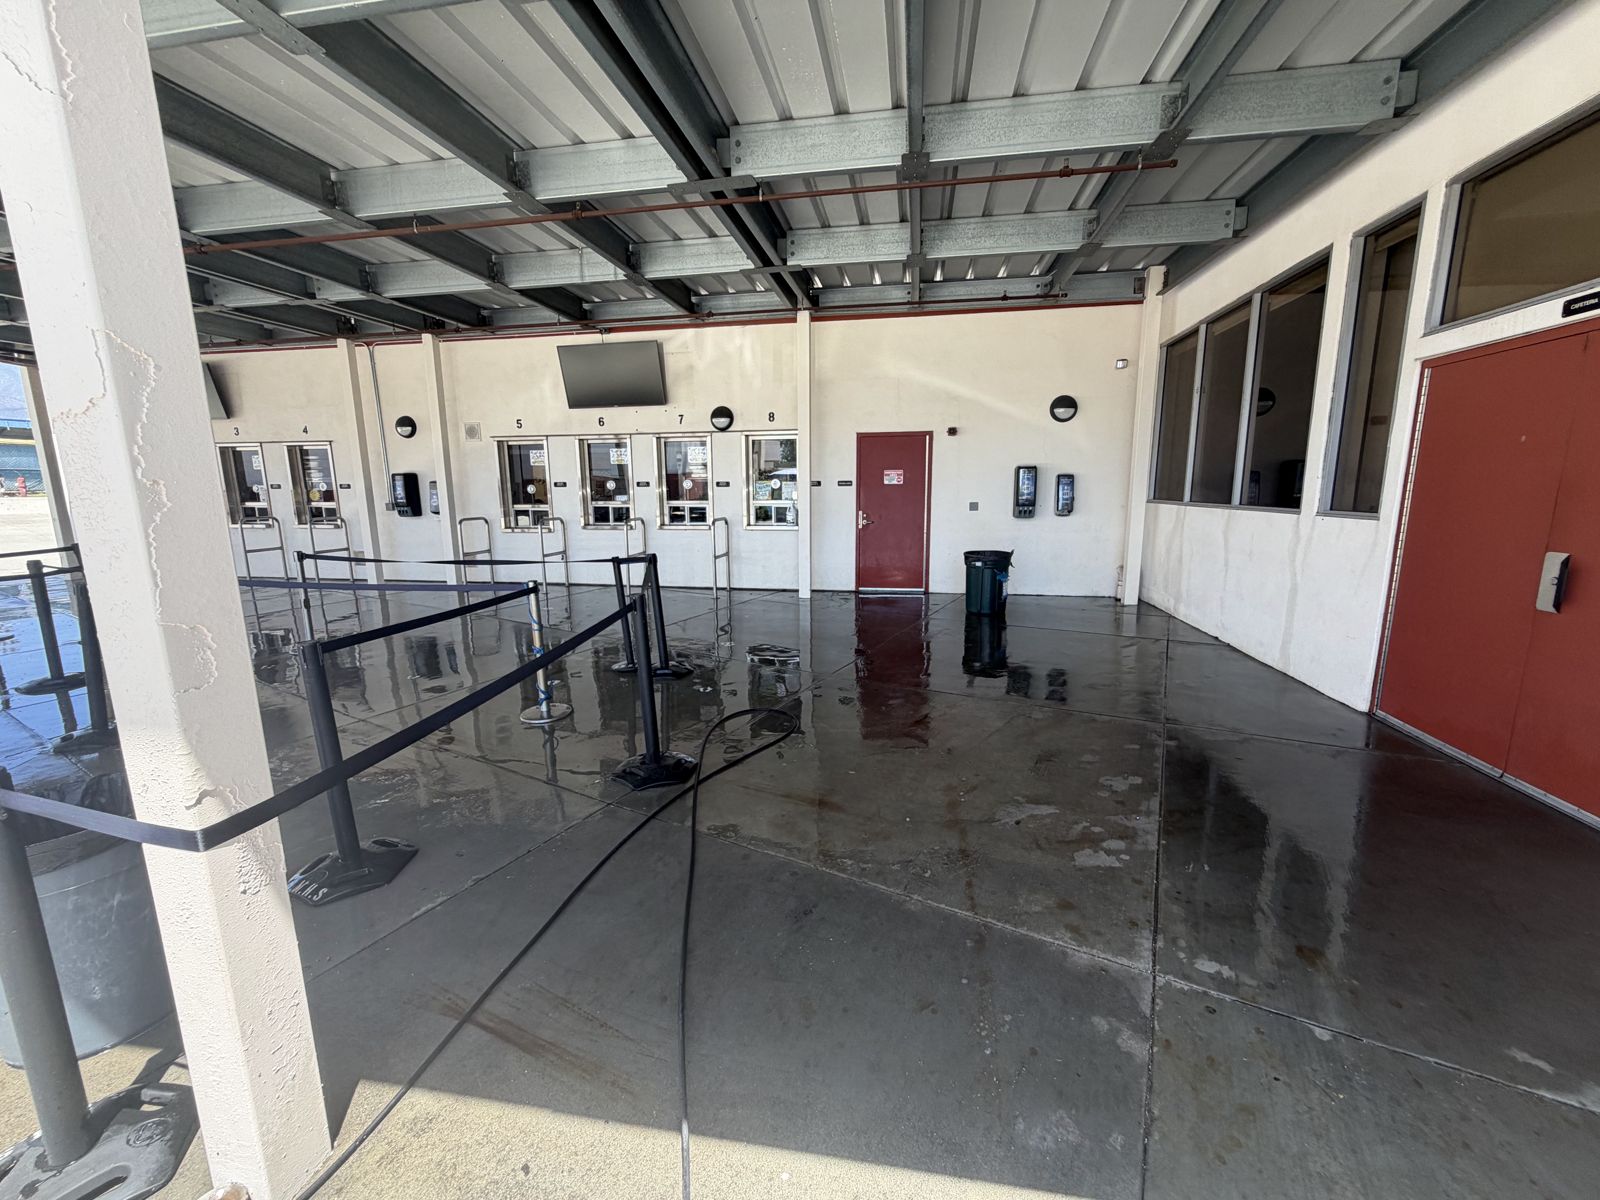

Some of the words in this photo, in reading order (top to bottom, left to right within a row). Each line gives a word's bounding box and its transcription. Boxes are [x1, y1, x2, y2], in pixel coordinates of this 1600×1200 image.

[1570, 298, 1598, 310] CAFETERIA
[598, 416, 604, 426] 6
[678, 414, 684, 424] 7
[768, 412, 776, 422] 8
[516, 418, 522, 428] 5
[234, 426, 240, 436] 3
[302, 426, 308, 434] 4
